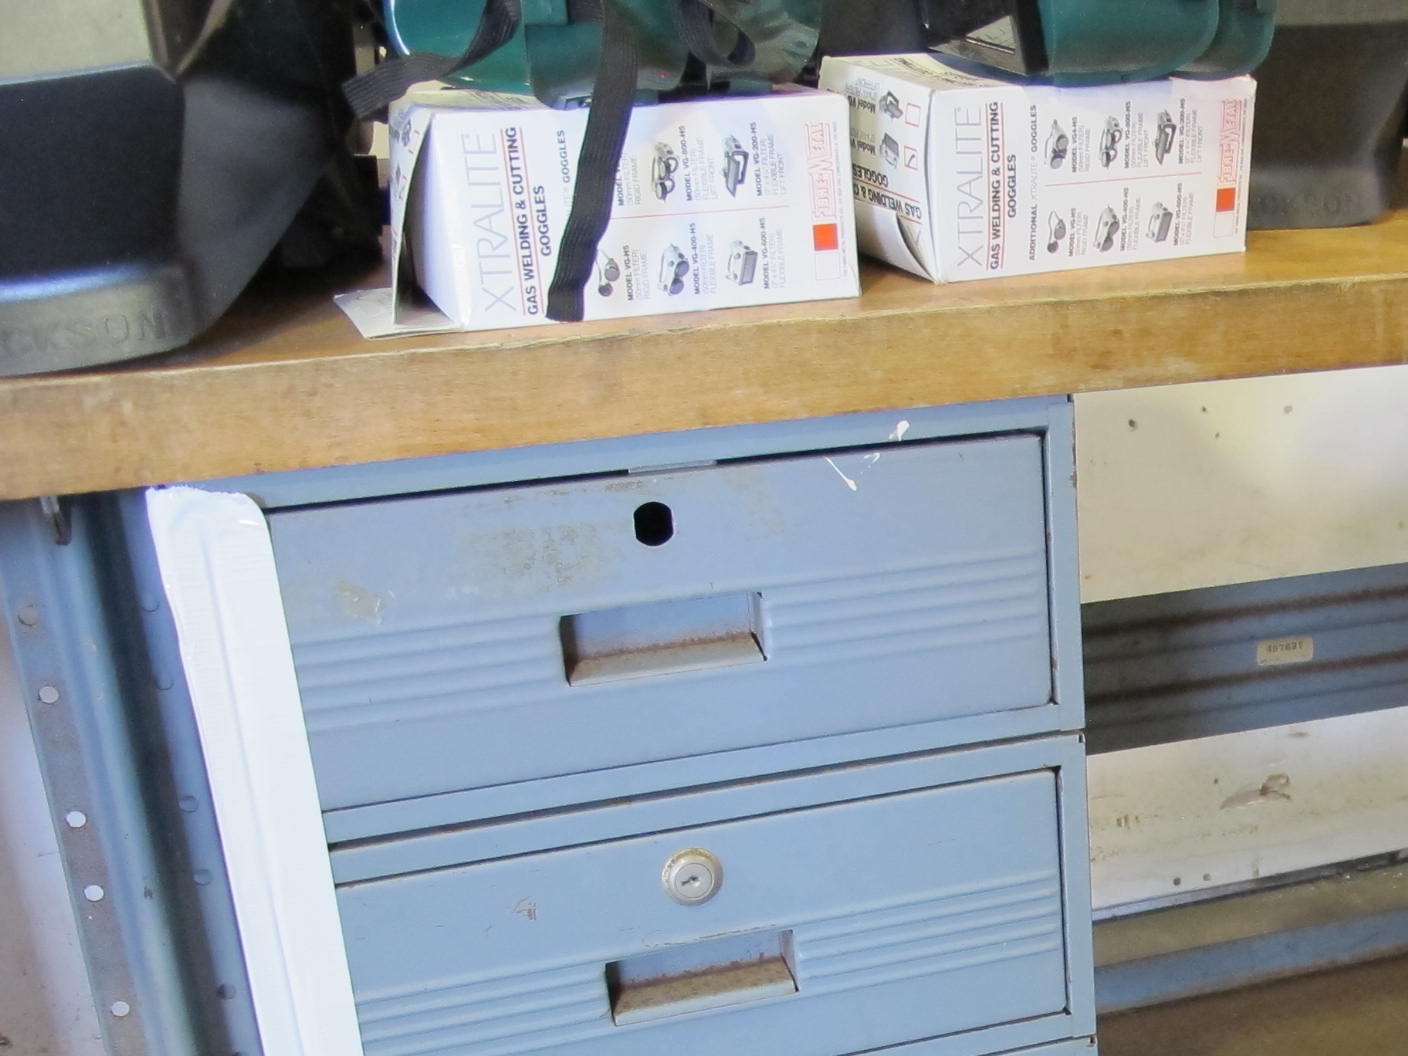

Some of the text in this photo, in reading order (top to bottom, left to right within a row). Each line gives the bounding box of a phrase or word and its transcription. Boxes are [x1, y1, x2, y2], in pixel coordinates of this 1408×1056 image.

[857, 98, 875, 113] Model
[557, 130, 570, 183] GOGGLES
[857, 141, 875, 155] Model
[684, 174, 693, 201] MODEL
[859, 187, 866, 198] &
[869, 189, 902, 215] WELDING
[904, 203, 922, 218] GAS
[954, 107, 983, 267] XTRALITE
[989, 102, 1001, 269] GAS WELDING & CUTTING
[1007, 155, 1016, 218] GOGGLES
[461, 133, 516, 312] XTRALITE
[505, 127, 538, 315] GAS WELDING & CUTTING
[534, 186, 551, 256] GOGGLES
[1029, 204, 1037, 260] ADDITIONAL
[623, 273, 633, 300] MODEL
